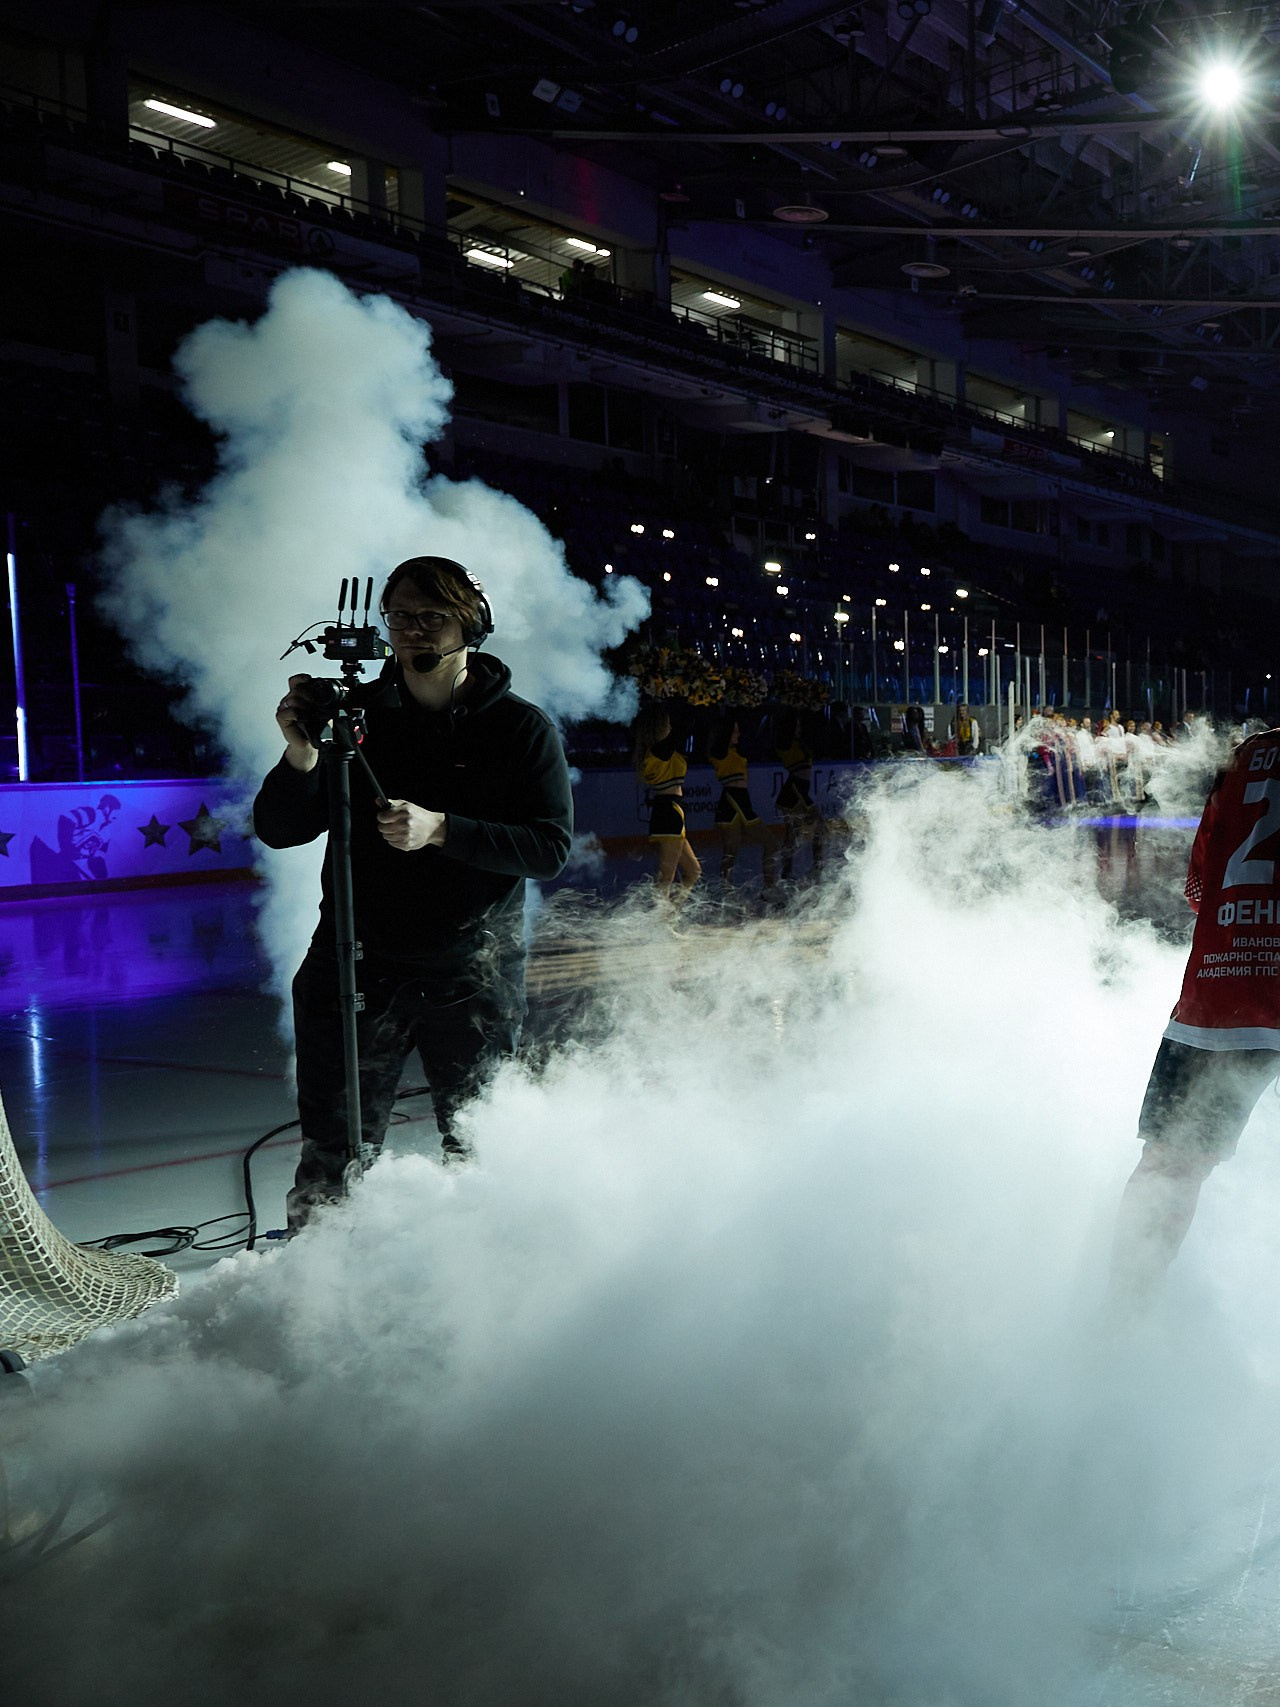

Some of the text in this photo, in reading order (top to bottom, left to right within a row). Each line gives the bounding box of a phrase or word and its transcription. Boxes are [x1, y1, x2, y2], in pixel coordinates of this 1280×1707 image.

[771, 769, 838, 799] ЛГА
[1196, 966, 1251, 979] АКАДЕМИЯ
[1255, 966, 1279, 977] ГПС
